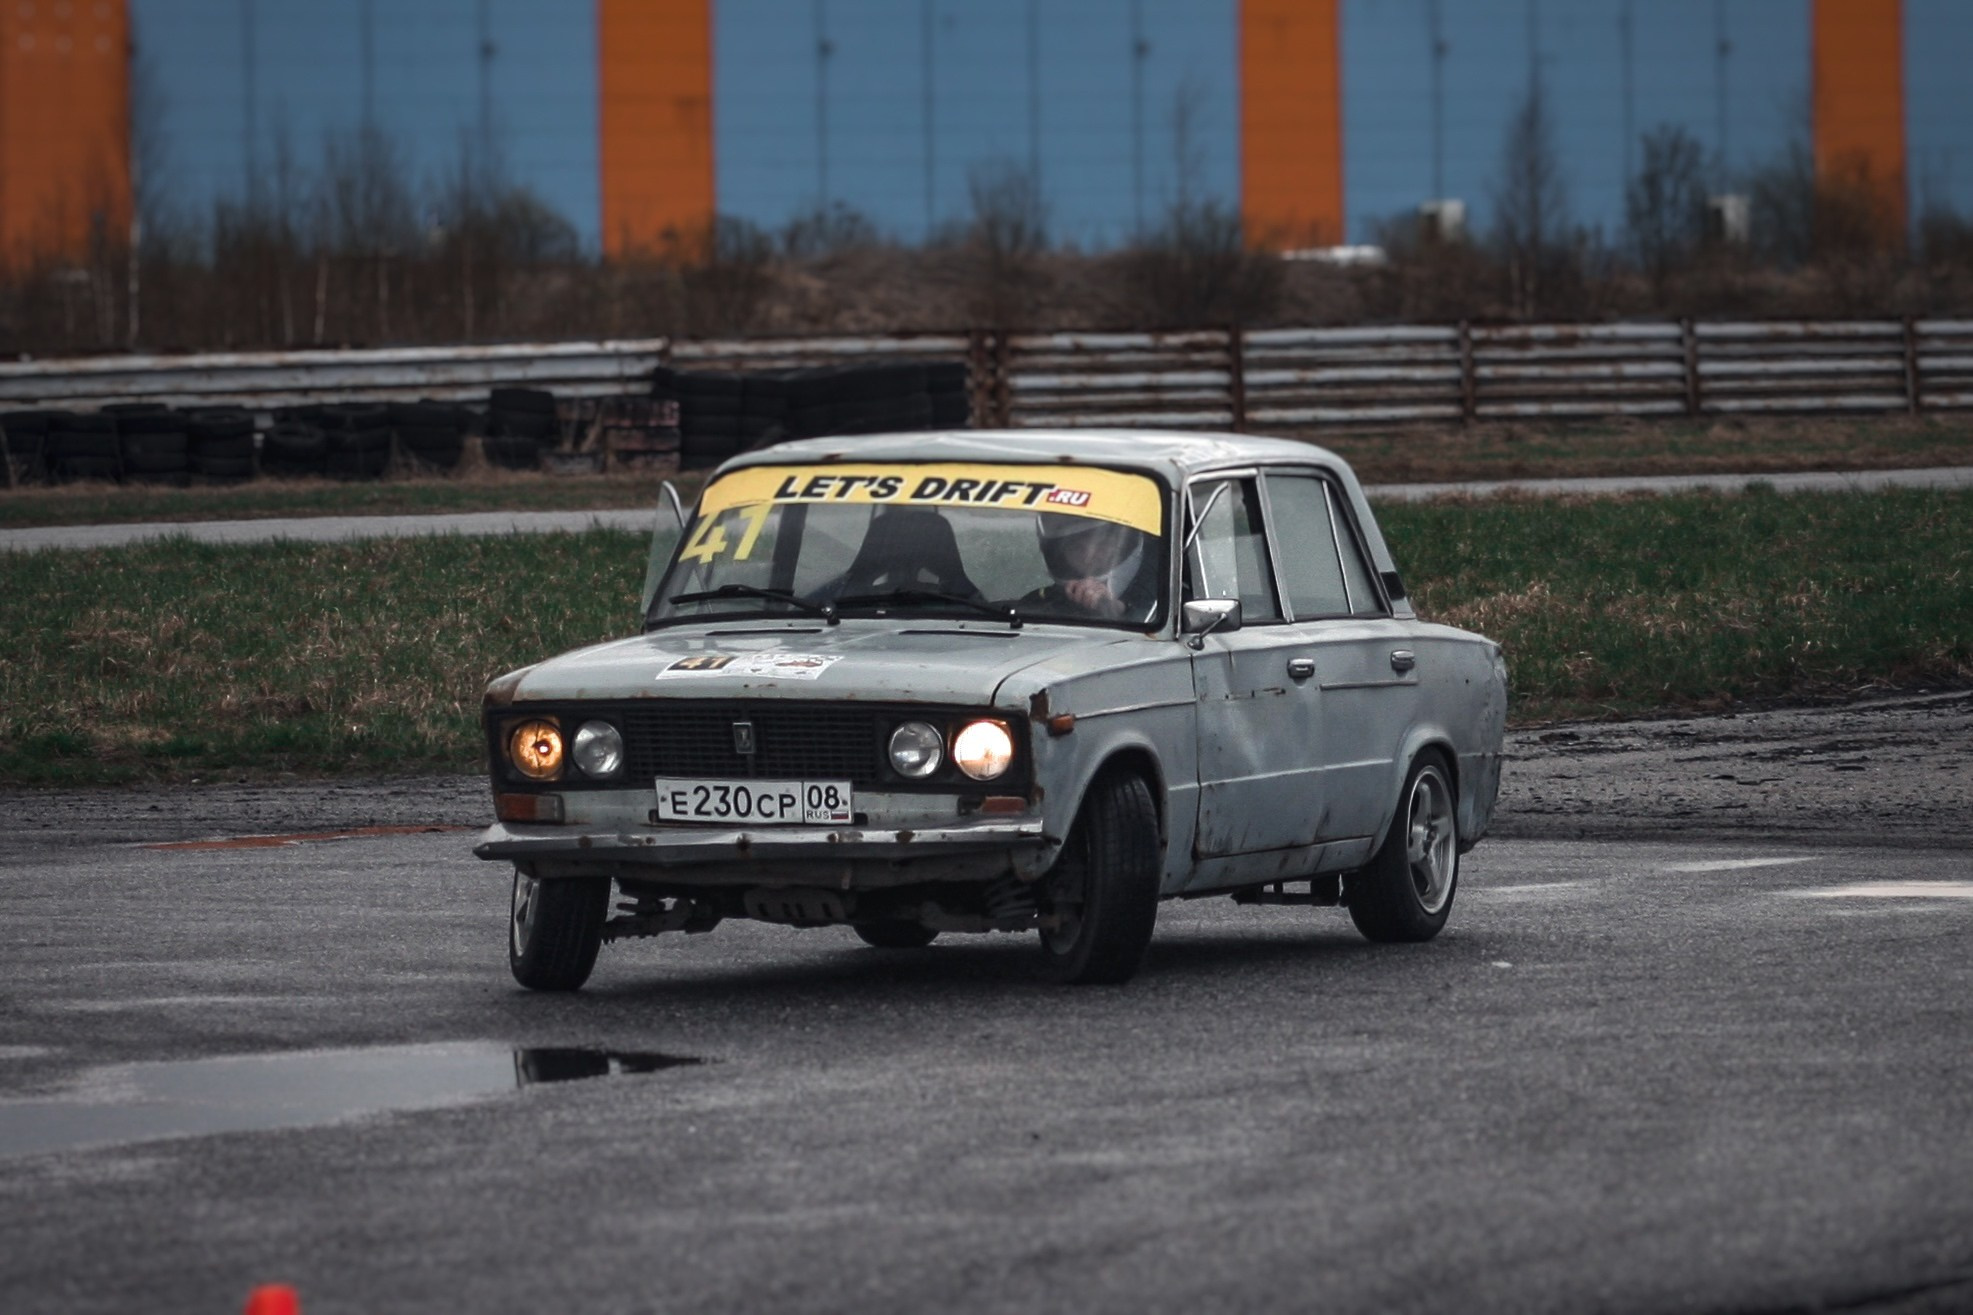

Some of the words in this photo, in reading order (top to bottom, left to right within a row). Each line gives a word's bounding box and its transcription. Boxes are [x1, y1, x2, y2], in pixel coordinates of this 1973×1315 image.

[774, 476, 902, 499] LET'S
[678, 501, 774, 564] 41
[807, 785, 840, 809] 08
[806, 810, 829, 819] RUS
